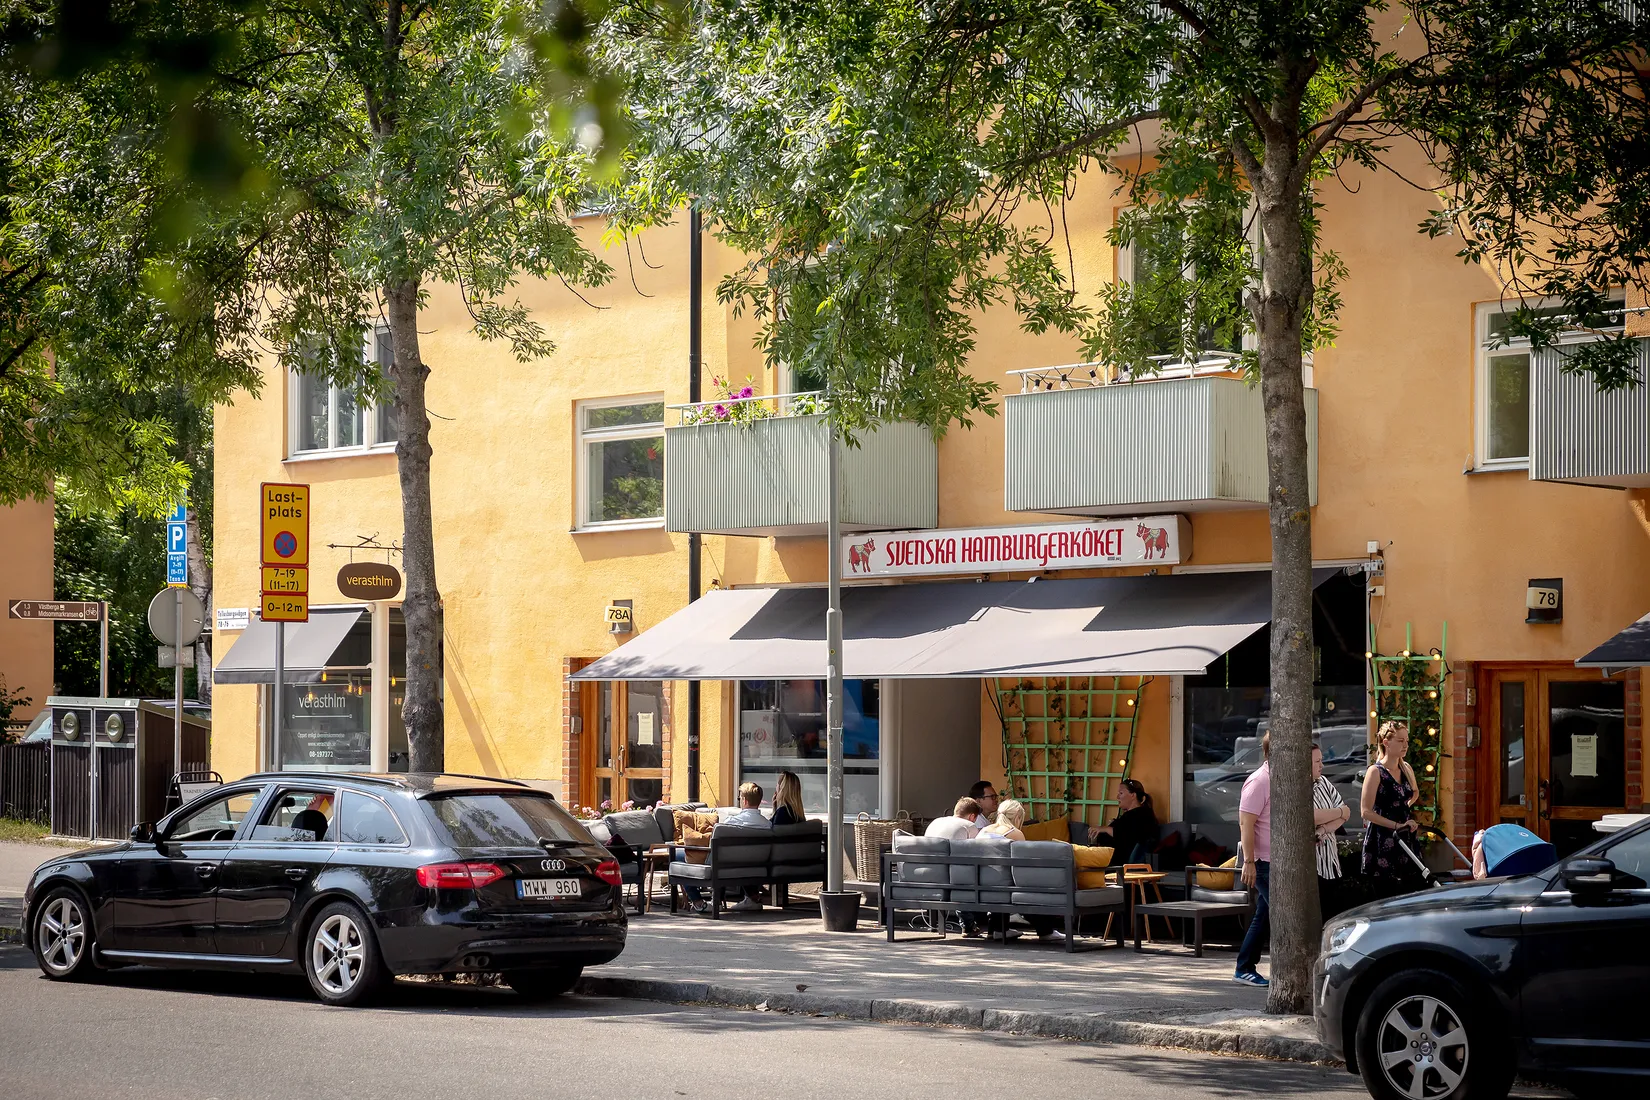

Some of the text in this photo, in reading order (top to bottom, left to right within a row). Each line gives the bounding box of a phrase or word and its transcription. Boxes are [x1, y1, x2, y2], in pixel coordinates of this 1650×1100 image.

[268, 490, 303, 502] Last-
[269, 505, 302, 519] plats
[172, 526, 183, 550] P
[886, 528, 1124, 567] SVENSKA HAMBURGERKÖKET
[273, 568, 296, 578] 7-19
[269, 580, 299, 591] (11-17)
[346, 575, 393, 587] verasthlm
[1539, 591, 1556, 606] 78
[38, 603, 59, 611] Västberga
[609, 609, 630, 620] 78A
[299, 693, 346, 708] verasthlm
[524, 880, 578, 895] MWW 960
